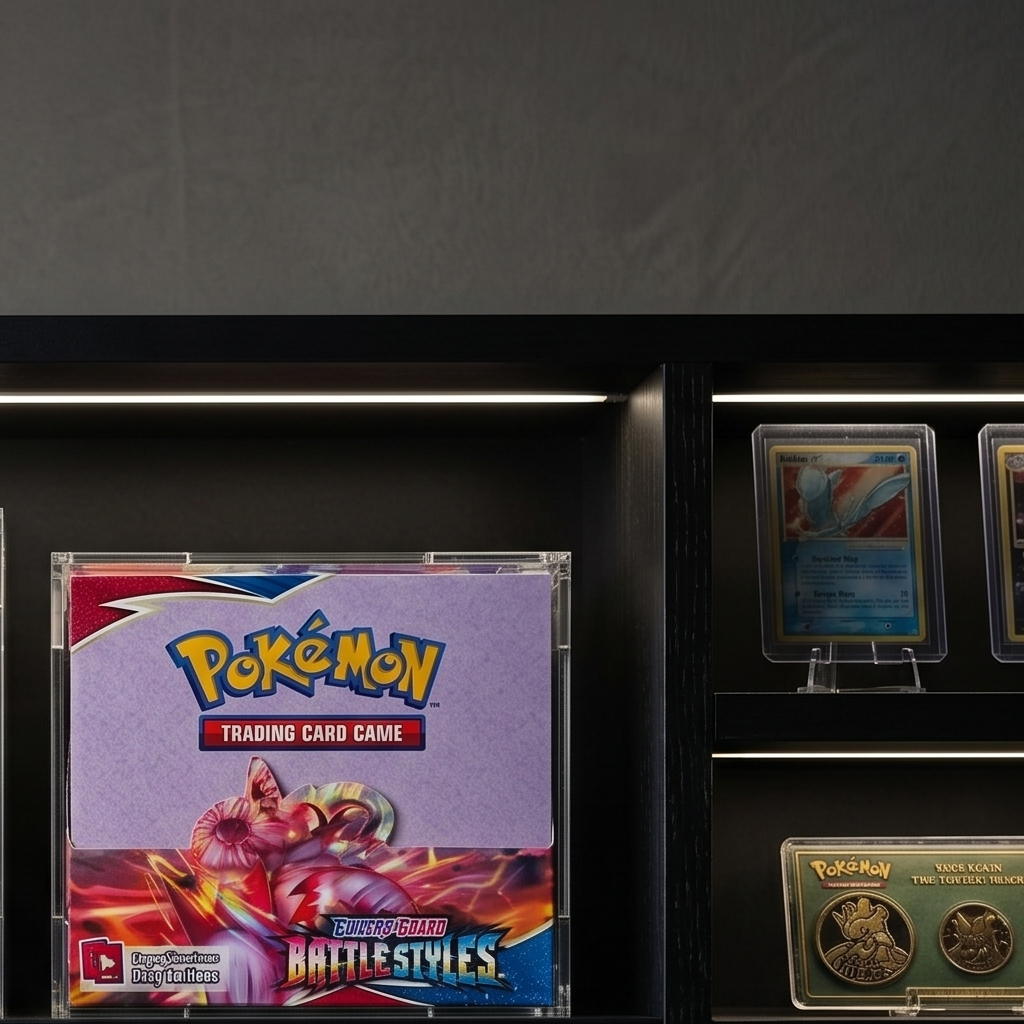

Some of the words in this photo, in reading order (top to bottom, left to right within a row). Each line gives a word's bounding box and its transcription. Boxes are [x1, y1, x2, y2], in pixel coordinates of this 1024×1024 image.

[221, 724, 296, 742] TRADING
[302, 724, 347, 742] CARD
[281, 936, 392, 989] BATTLE
[393, 931, 508, 990] STYLES
